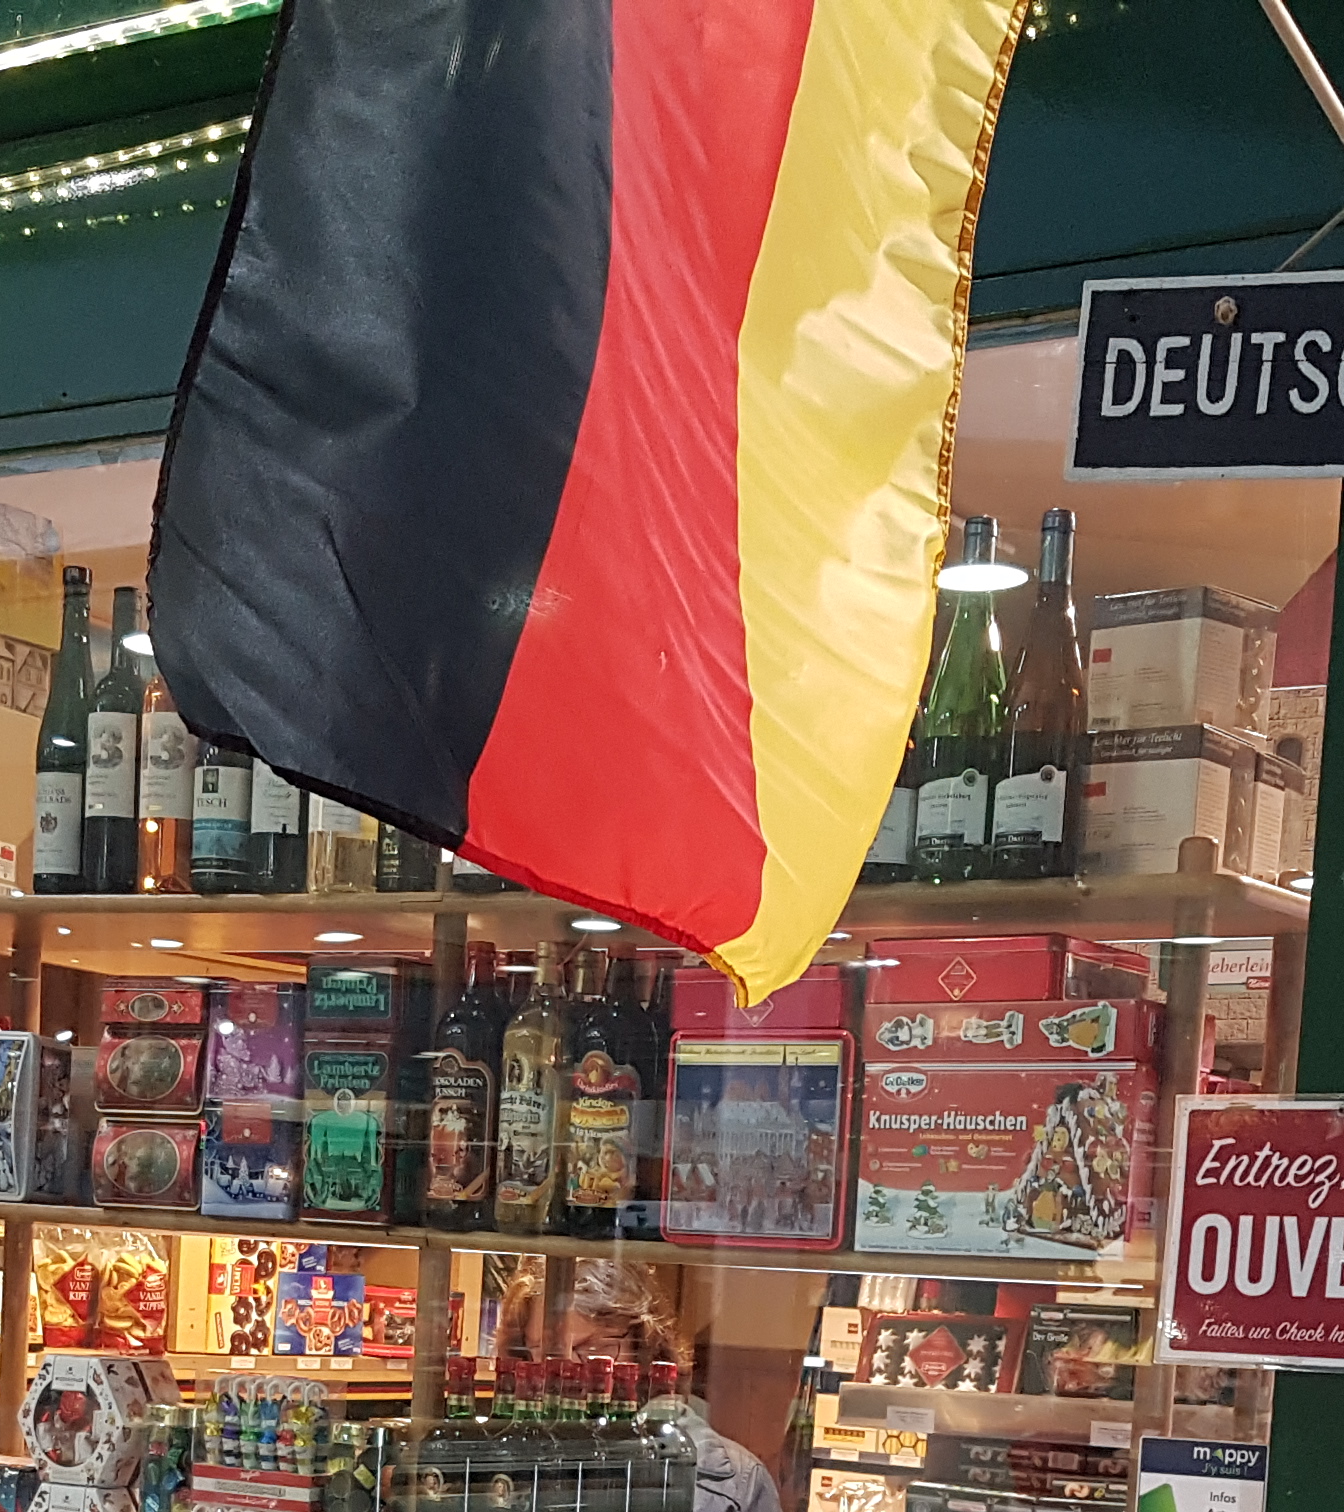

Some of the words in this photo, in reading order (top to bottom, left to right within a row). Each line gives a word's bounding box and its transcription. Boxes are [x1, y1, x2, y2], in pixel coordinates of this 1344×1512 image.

[313, 1061, 380, 1078] Lambertz
[868, 1110, 1028, 1132] Knusper-Häuschen
[1199, 1318, 1246, 1339] Faites
[1248, 1326, 1271, 1341] un
[1275, 1321, 1326, 1343] Check
[1219, 1466, 1241, 1477] suis
[1209, 1491, 1237, 1504] Infos
